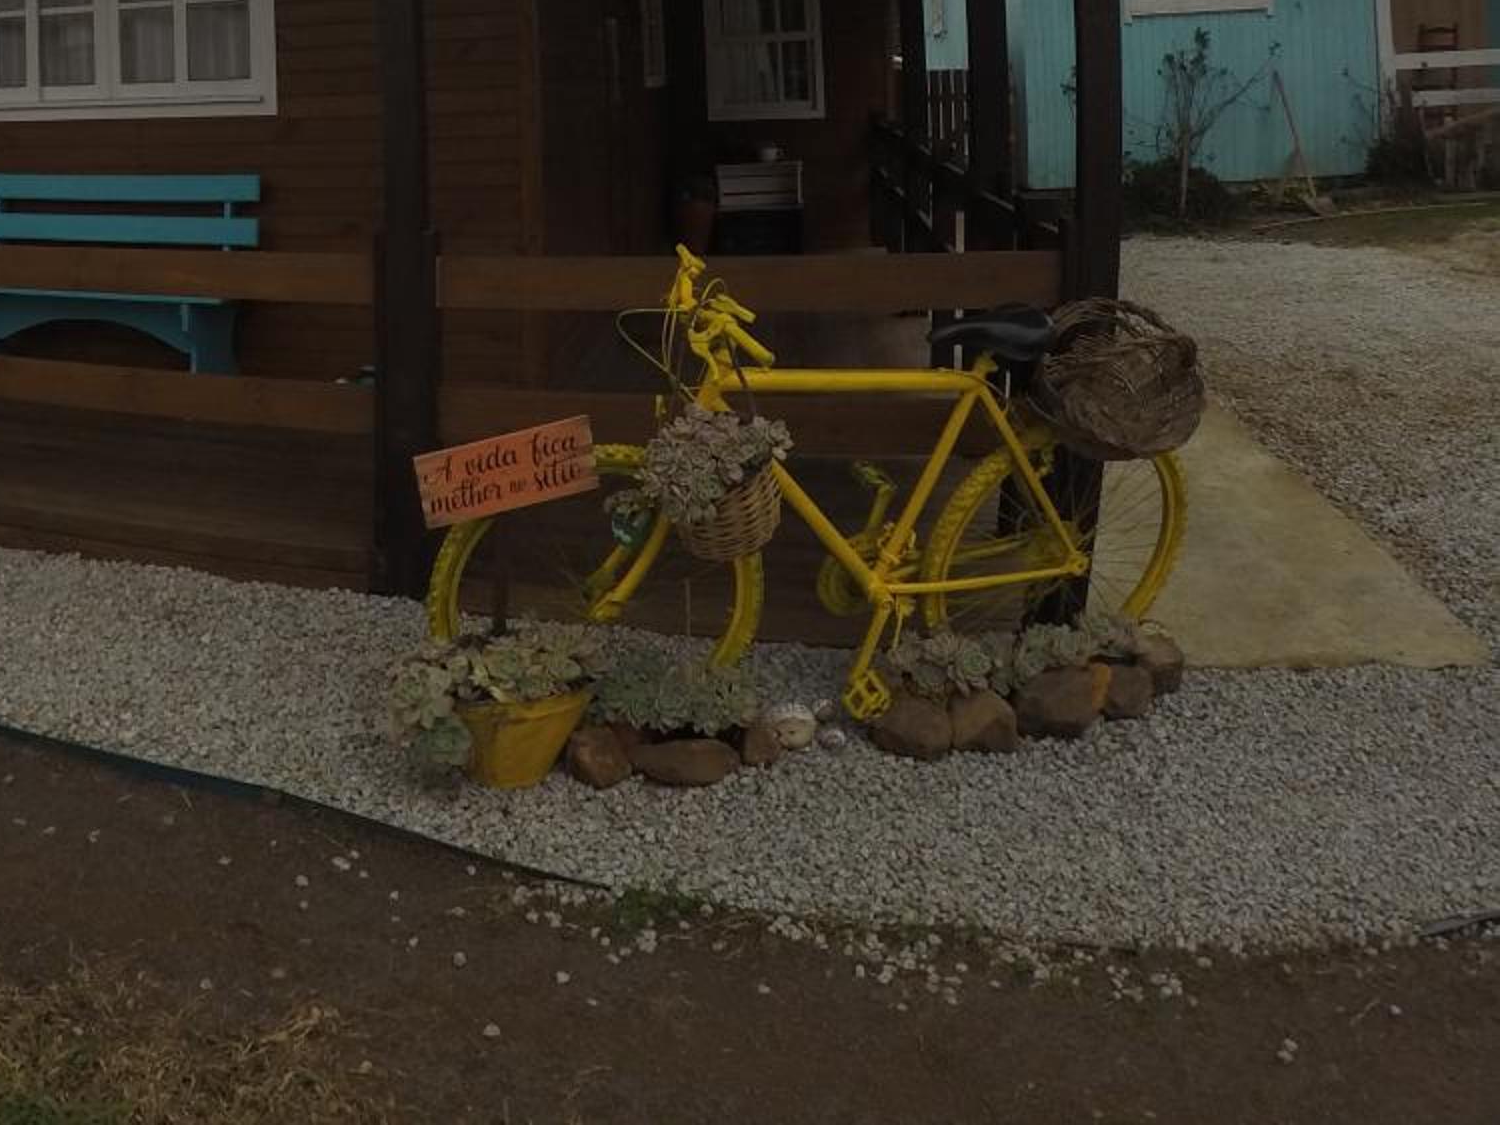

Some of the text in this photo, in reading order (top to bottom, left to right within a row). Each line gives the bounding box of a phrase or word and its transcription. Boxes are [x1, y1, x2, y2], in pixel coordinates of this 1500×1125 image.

[423, 432, 579, 484] A vida fica
[430, 478, 502, 514] melhor
